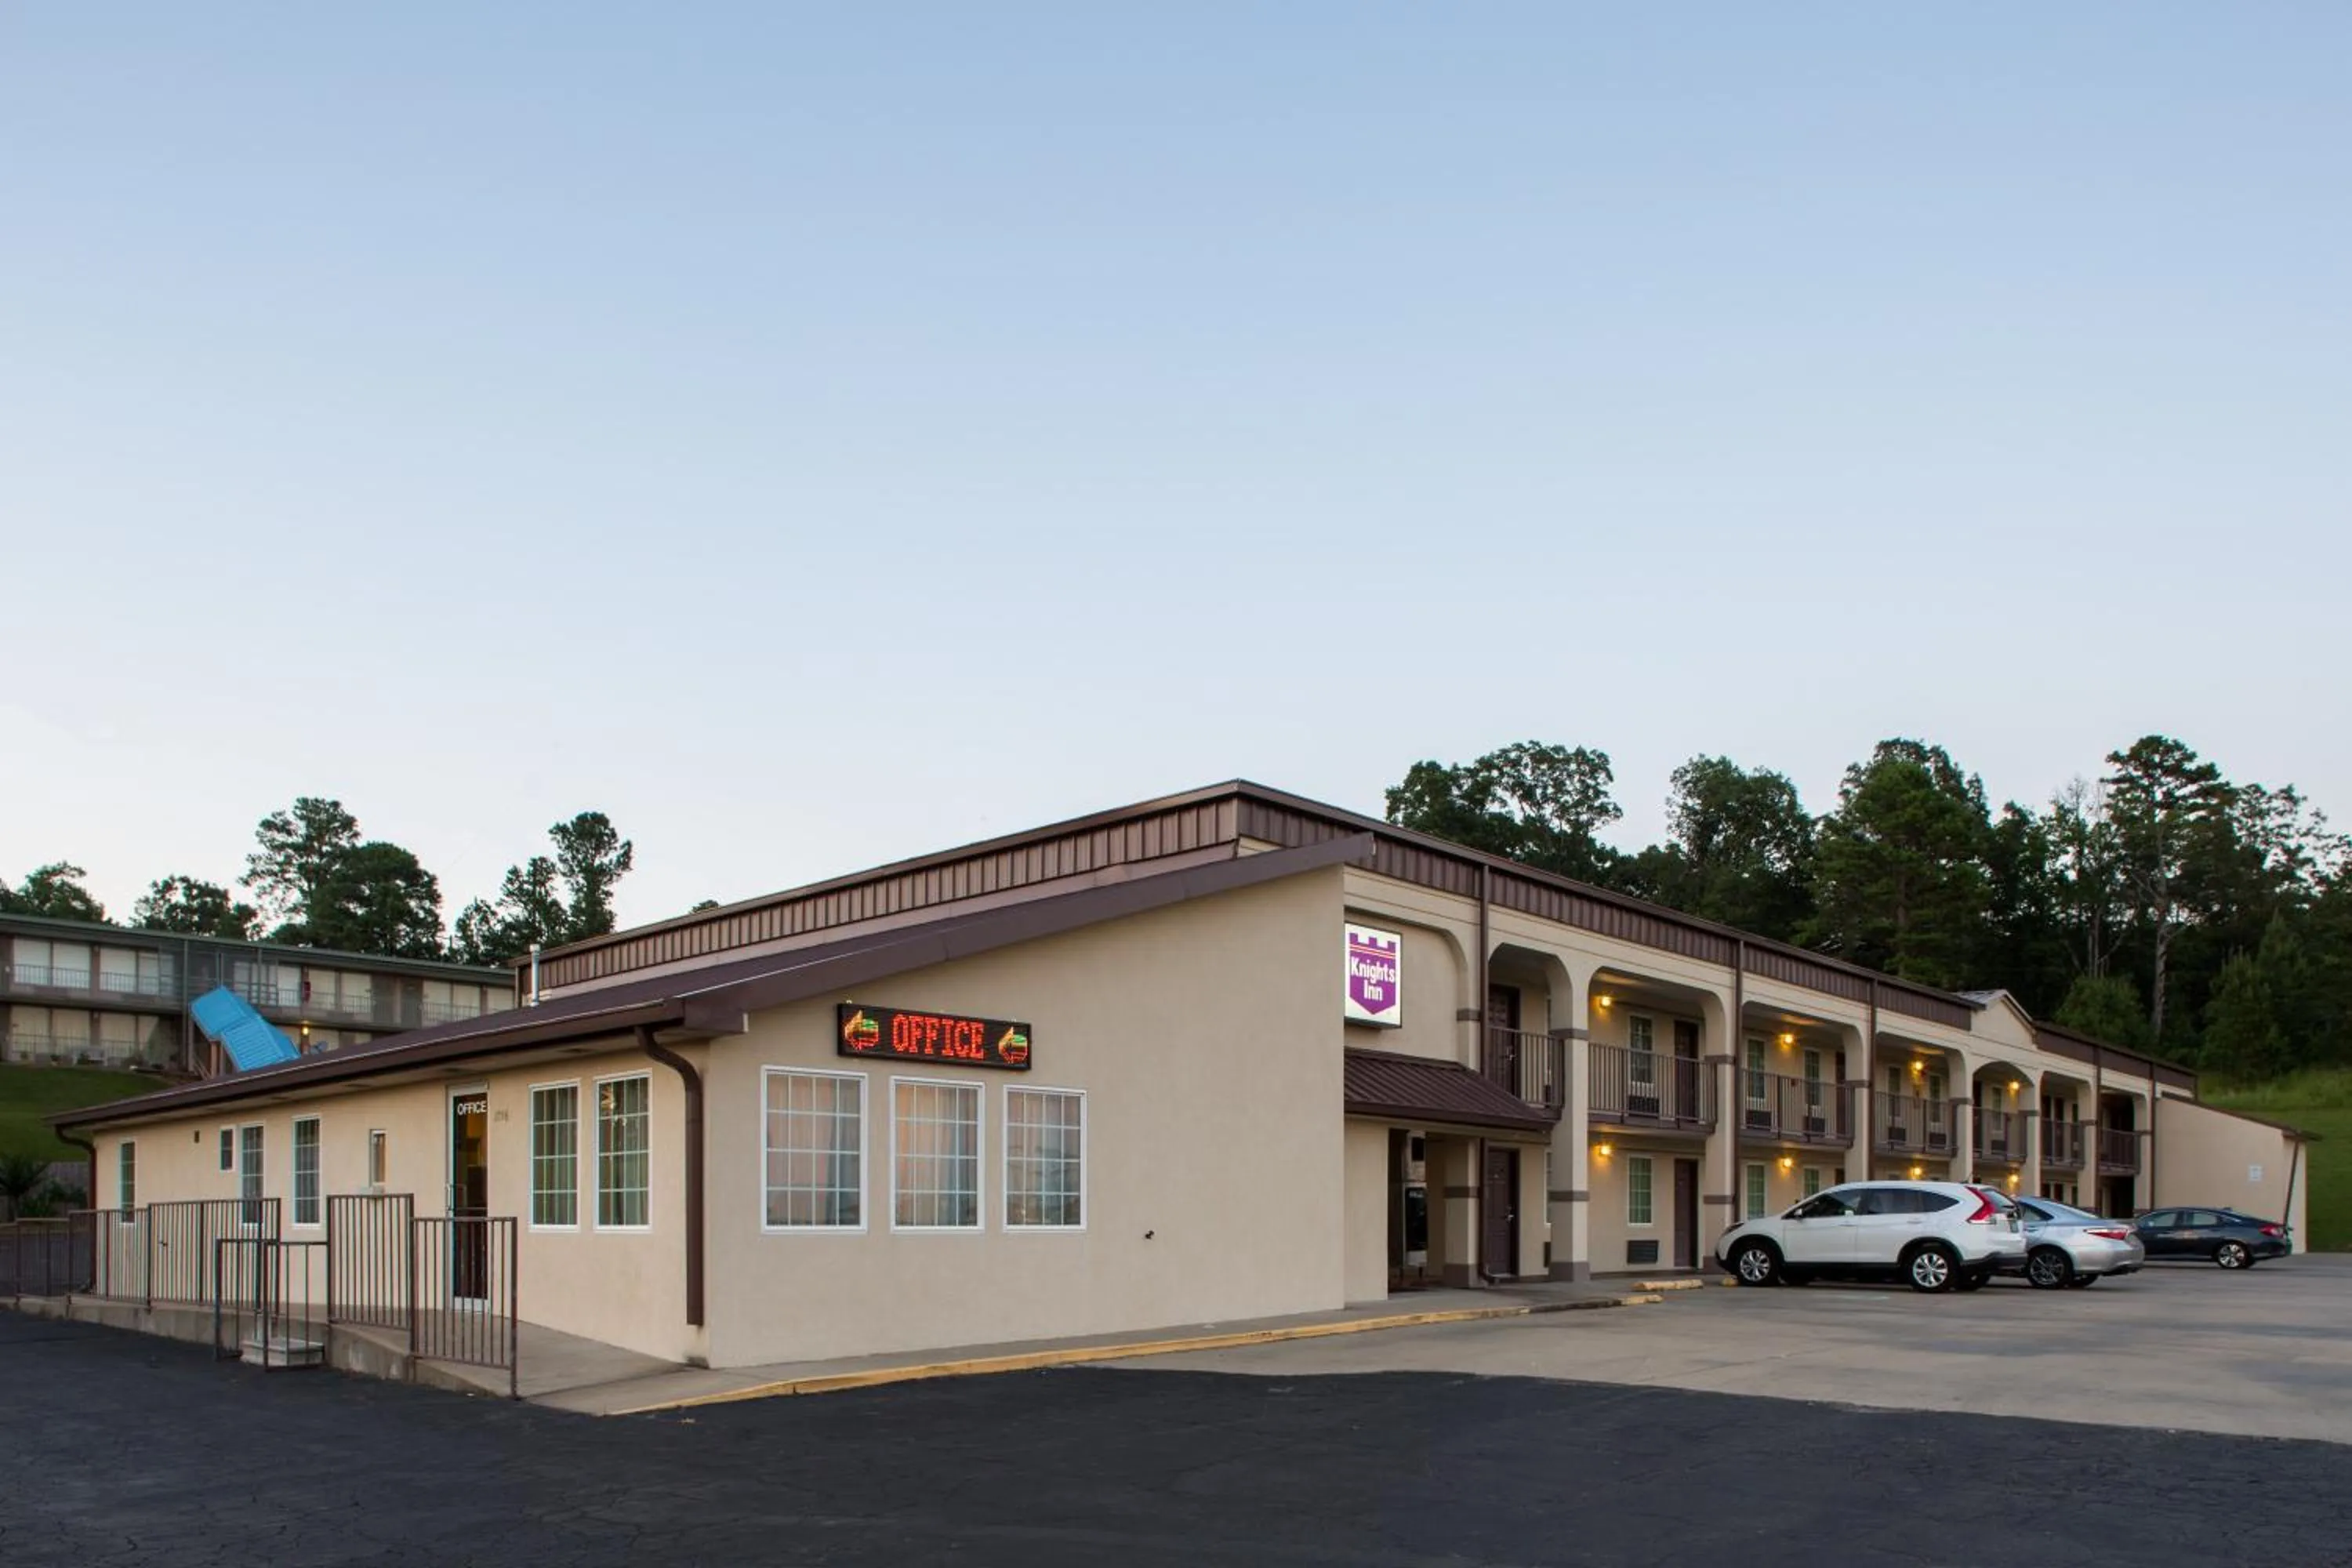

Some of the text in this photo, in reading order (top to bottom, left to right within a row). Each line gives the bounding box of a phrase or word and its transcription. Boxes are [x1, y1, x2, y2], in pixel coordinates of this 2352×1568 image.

[1351, 956, 1395, 983] Knights
[1363, 979, 1383, 1001] Inn
[892, 1014, 985, 1058] OFFICE
[457, 1100, 487, 1116] OFFICE
